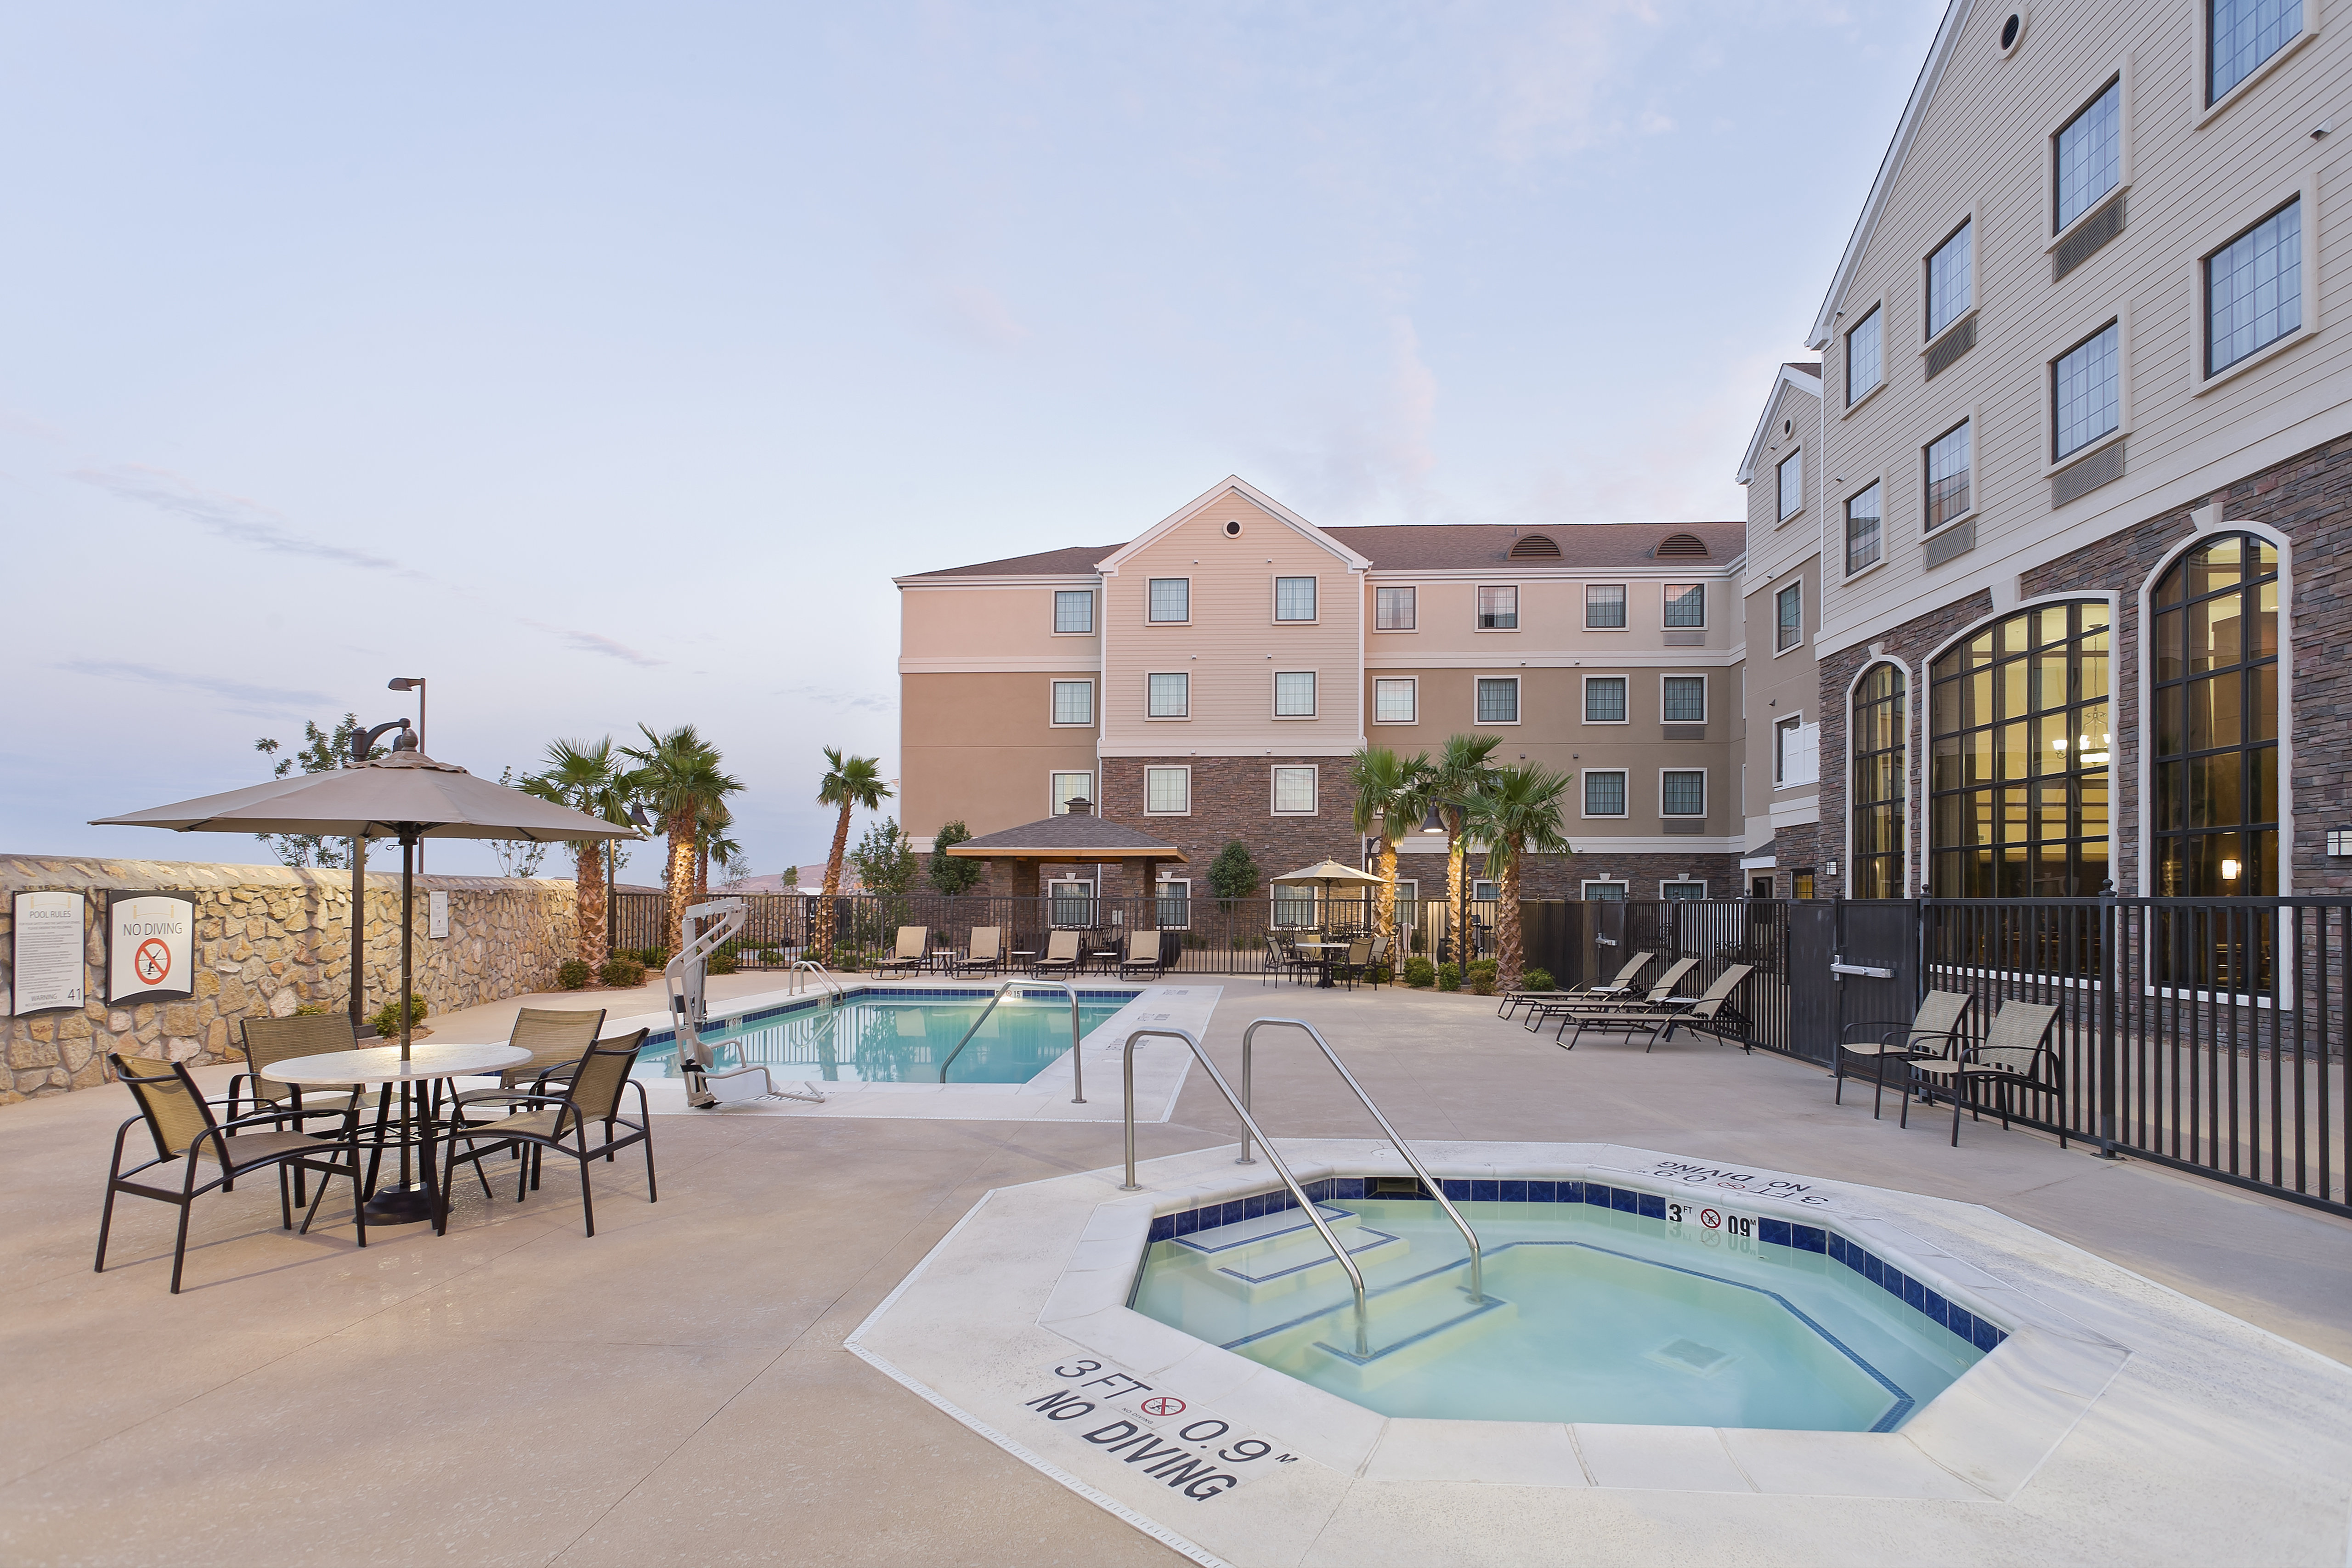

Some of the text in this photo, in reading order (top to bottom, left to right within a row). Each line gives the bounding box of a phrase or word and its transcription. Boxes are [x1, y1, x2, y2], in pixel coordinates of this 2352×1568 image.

[124, 923, 182, 936] NO DIVING
[68, 988, 80, 1001] 41
[1657, 1162, 1755, 1181] DIVING
[1749, 1188, 1795, 1198] FT
[1769, 1181, 1811, 1192] NO
[1800, 1196, 1828, 1204] 3
[1669, 1204, 1682, 1222] 3
[1683, 1206, 1692, 1214] FT
[1055, 1360, 1298, 1465] 3 FT 0.9 M
[1132, 1413, 1153, 1424] DIVING
[1024, 1390, 1237, 1502] NO DIVING
